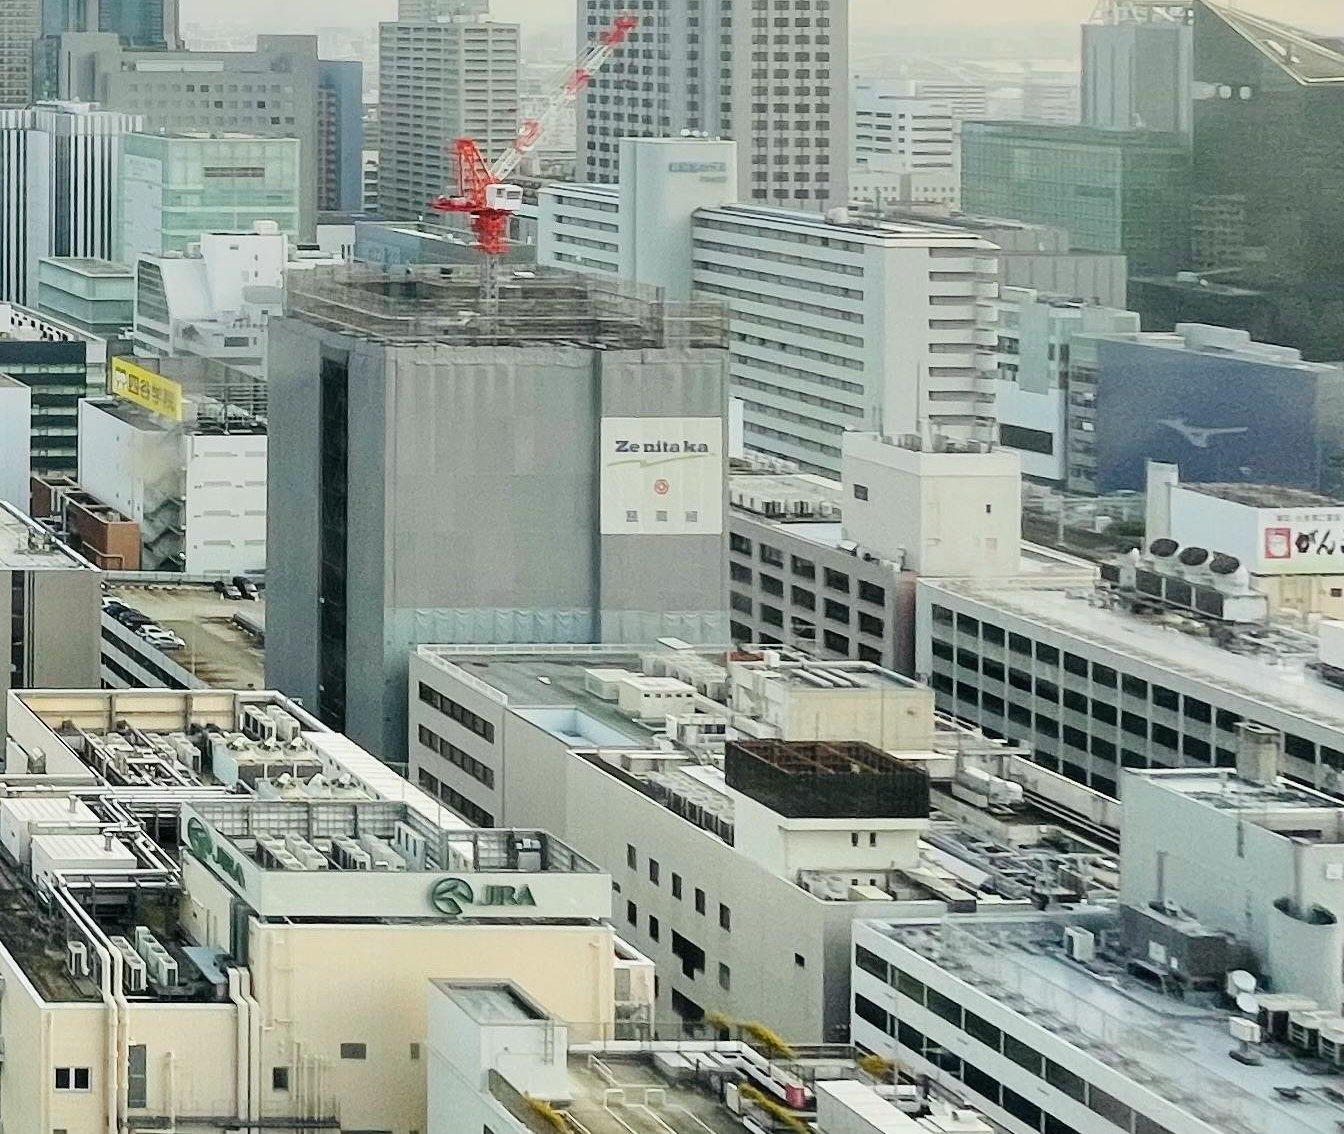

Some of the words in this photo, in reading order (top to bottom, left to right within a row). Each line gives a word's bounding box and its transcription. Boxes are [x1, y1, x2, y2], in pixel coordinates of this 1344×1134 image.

[615, 440, 709, 454] Zenitaka
[1295, 529, 1344, 556] がん
[477, 884, 537, 906] JRA
